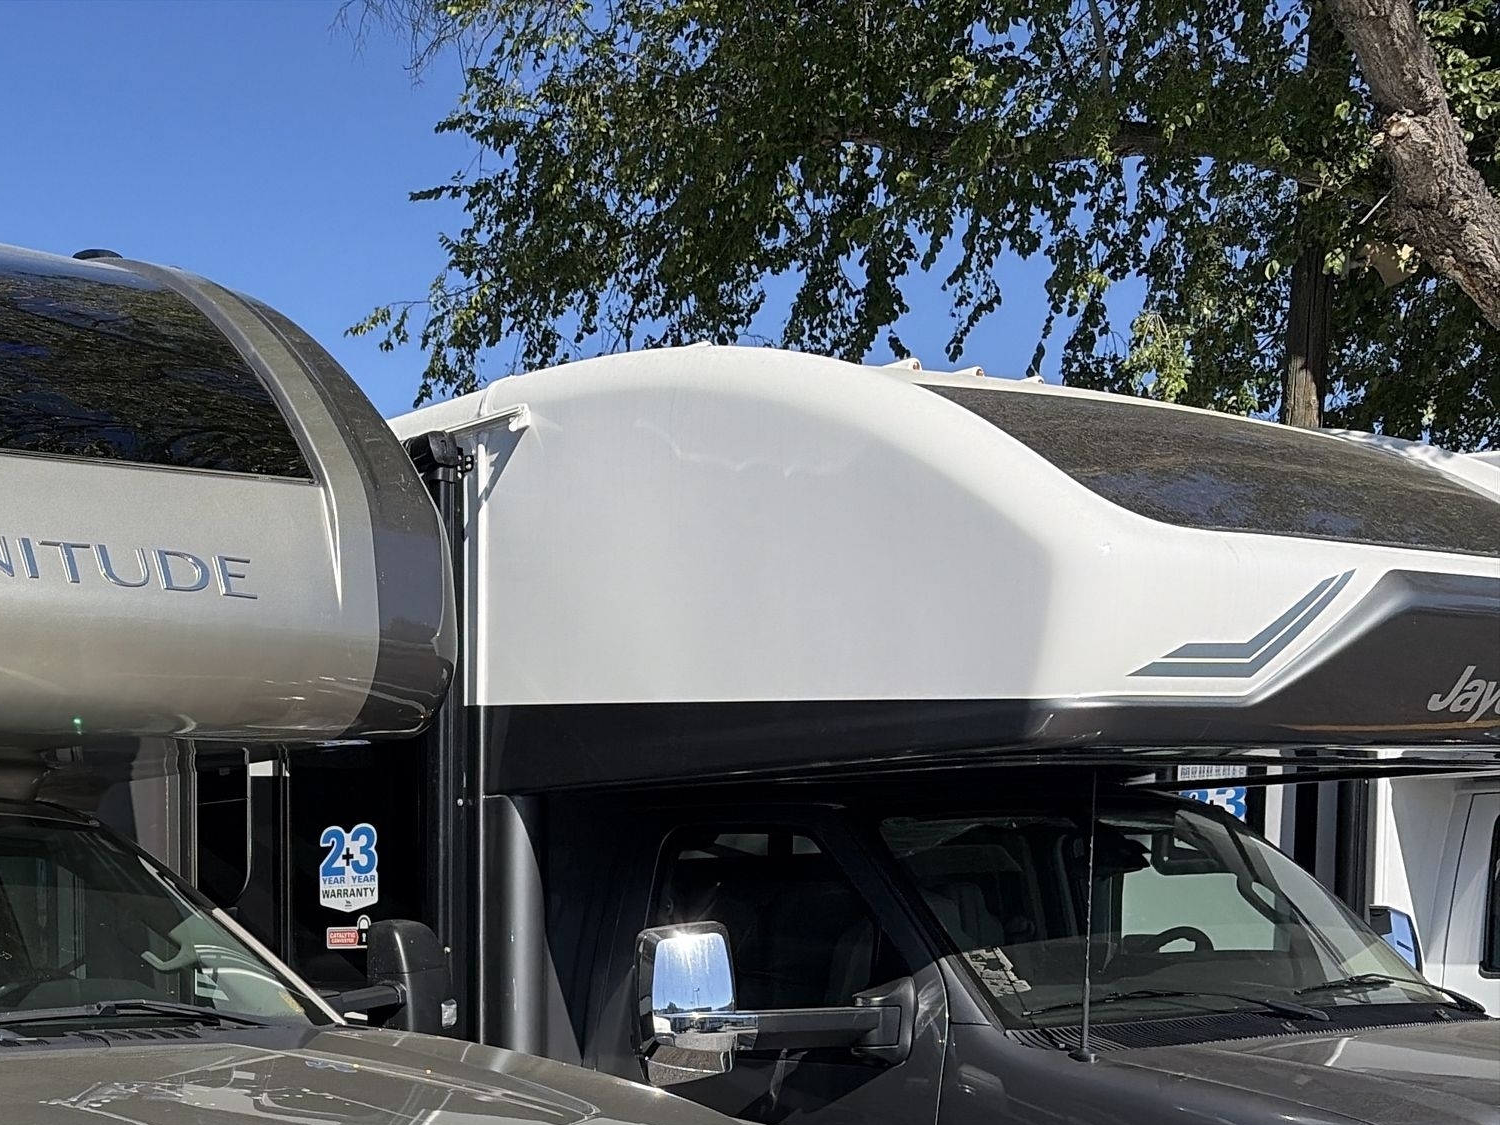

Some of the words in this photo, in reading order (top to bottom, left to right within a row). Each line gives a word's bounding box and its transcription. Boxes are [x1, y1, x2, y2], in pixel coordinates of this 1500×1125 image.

[1426, 665, 1500, 724] Jay
[322, 876, 346, 885] YEAR
[351, 874, 376, 883] YEAR
[321, 887, 376, 899] WARRANTY
